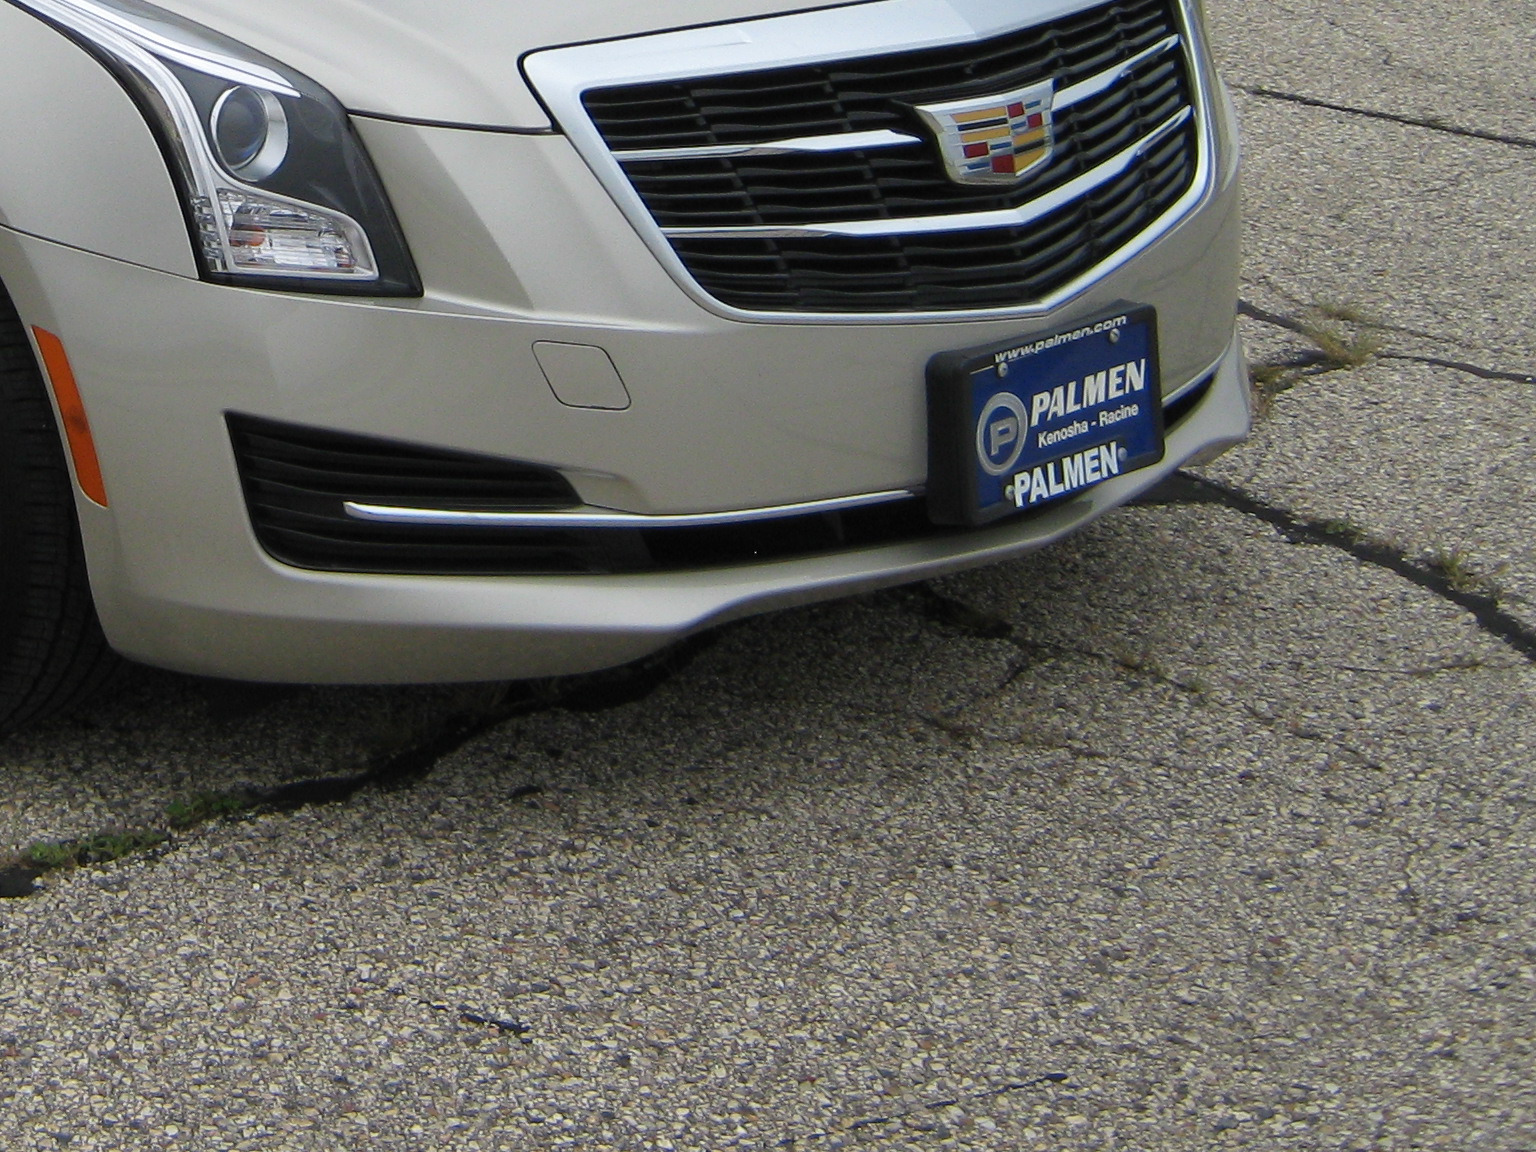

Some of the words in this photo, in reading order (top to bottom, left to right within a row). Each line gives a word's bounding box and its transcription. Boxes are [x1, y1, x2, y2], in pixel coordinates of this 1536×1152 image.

[994, 314, 1126, 364] www.palmen.com
[1030, 358, 1146, 427] PALMEN
[1037, 420, 1089, 448] Kenosha
[1099, 402, 1139, 428] Racine
[1014, 441, 1119, 508] PALMEN
